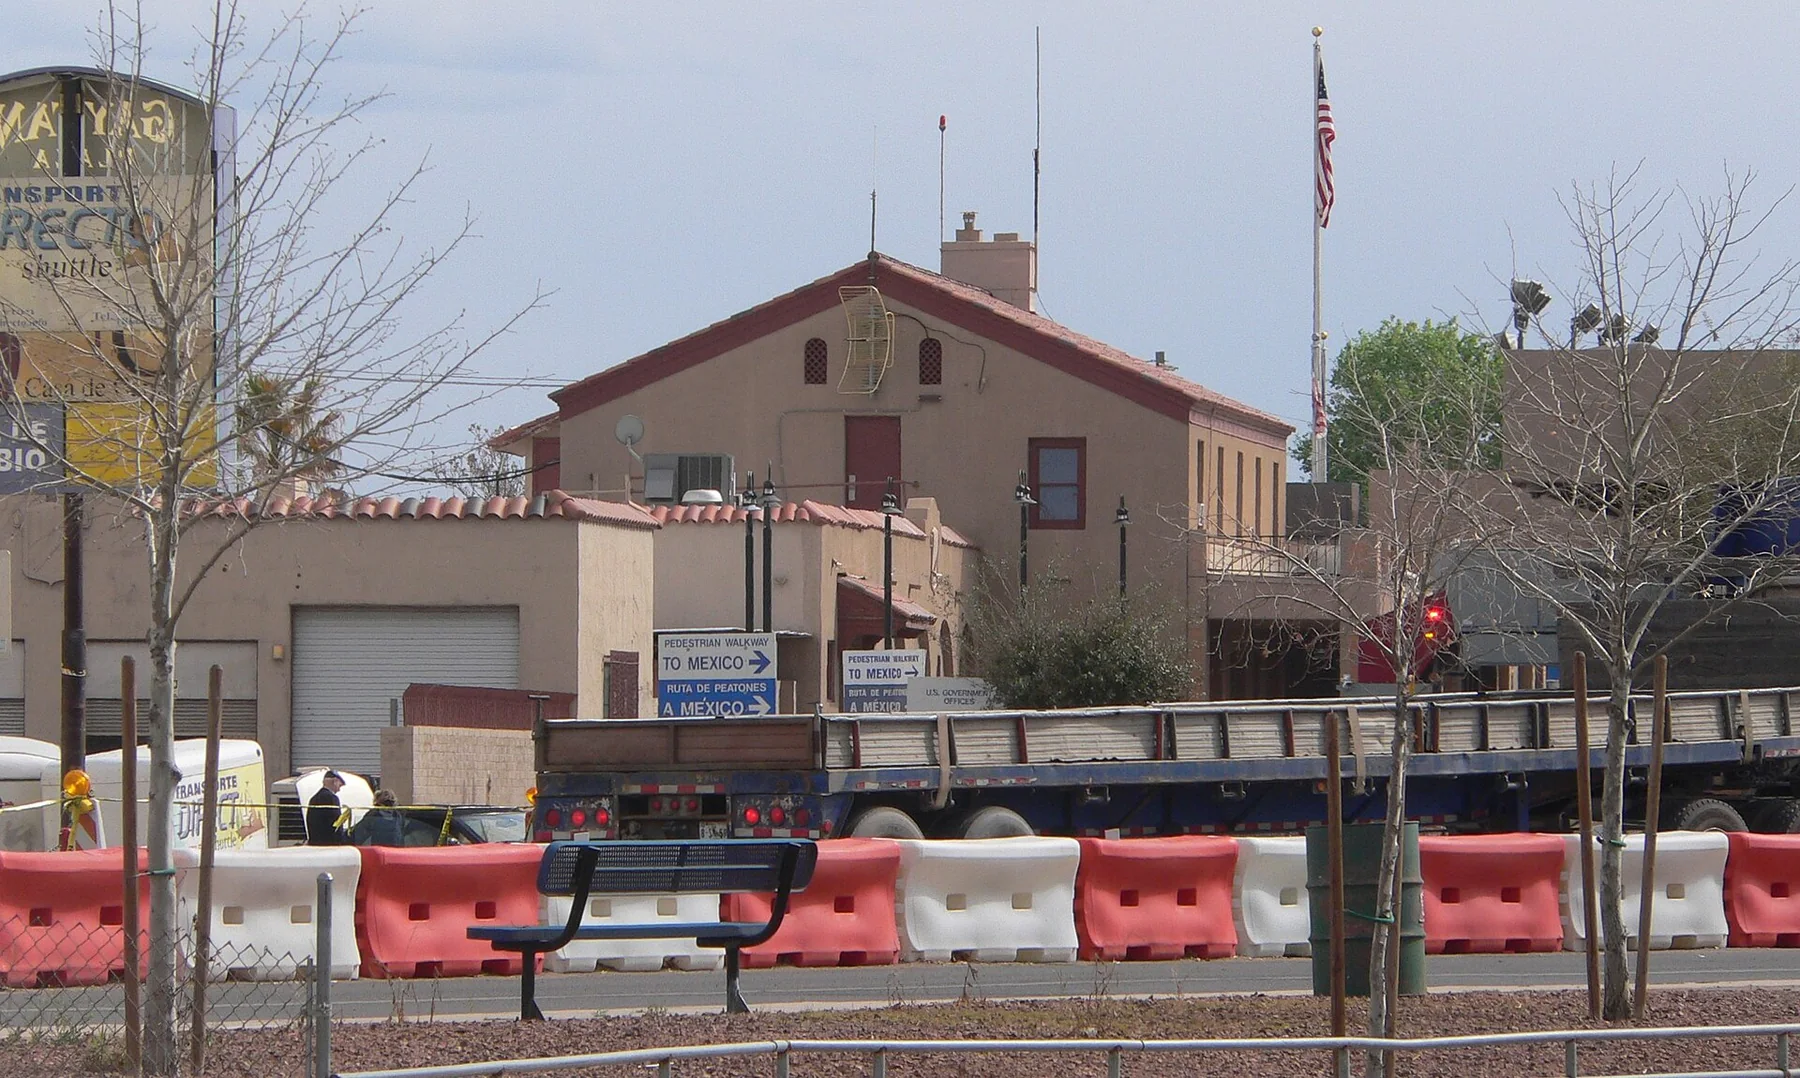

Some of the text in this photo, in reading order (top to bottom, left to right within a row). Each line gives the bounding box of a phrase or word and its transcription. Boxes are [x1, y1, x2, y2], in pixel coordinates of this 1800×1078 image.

[22, 254, 113, 278] shuttle
[25, 378, 74, 398] Casa
[82, 378, 106, 397] de
[0, 448, 46, 471] BIO
[664, 638, 769, 648] PEDESTRIAN WALKWAY
[663, 656, 744, 671] TO MEXICO
[848, 655, 891, 663] PEDESTRIAN
[848, 668, 902, 680] TO MEXICO
[667, 682, 767, 693] RUTA DE PEATONES
[848, 689, 867, 697] RUTA
[870, 689, 880, 697] DE
[926, 689, 990, 697] U.S. GOVERNMEN
[663, 697, 744, 716] A MÉXICO
[944, 697, 975, 705] OFFICES
[850, 702, 858, 713] A
[176, 775, 237, 799] TRANRTE
